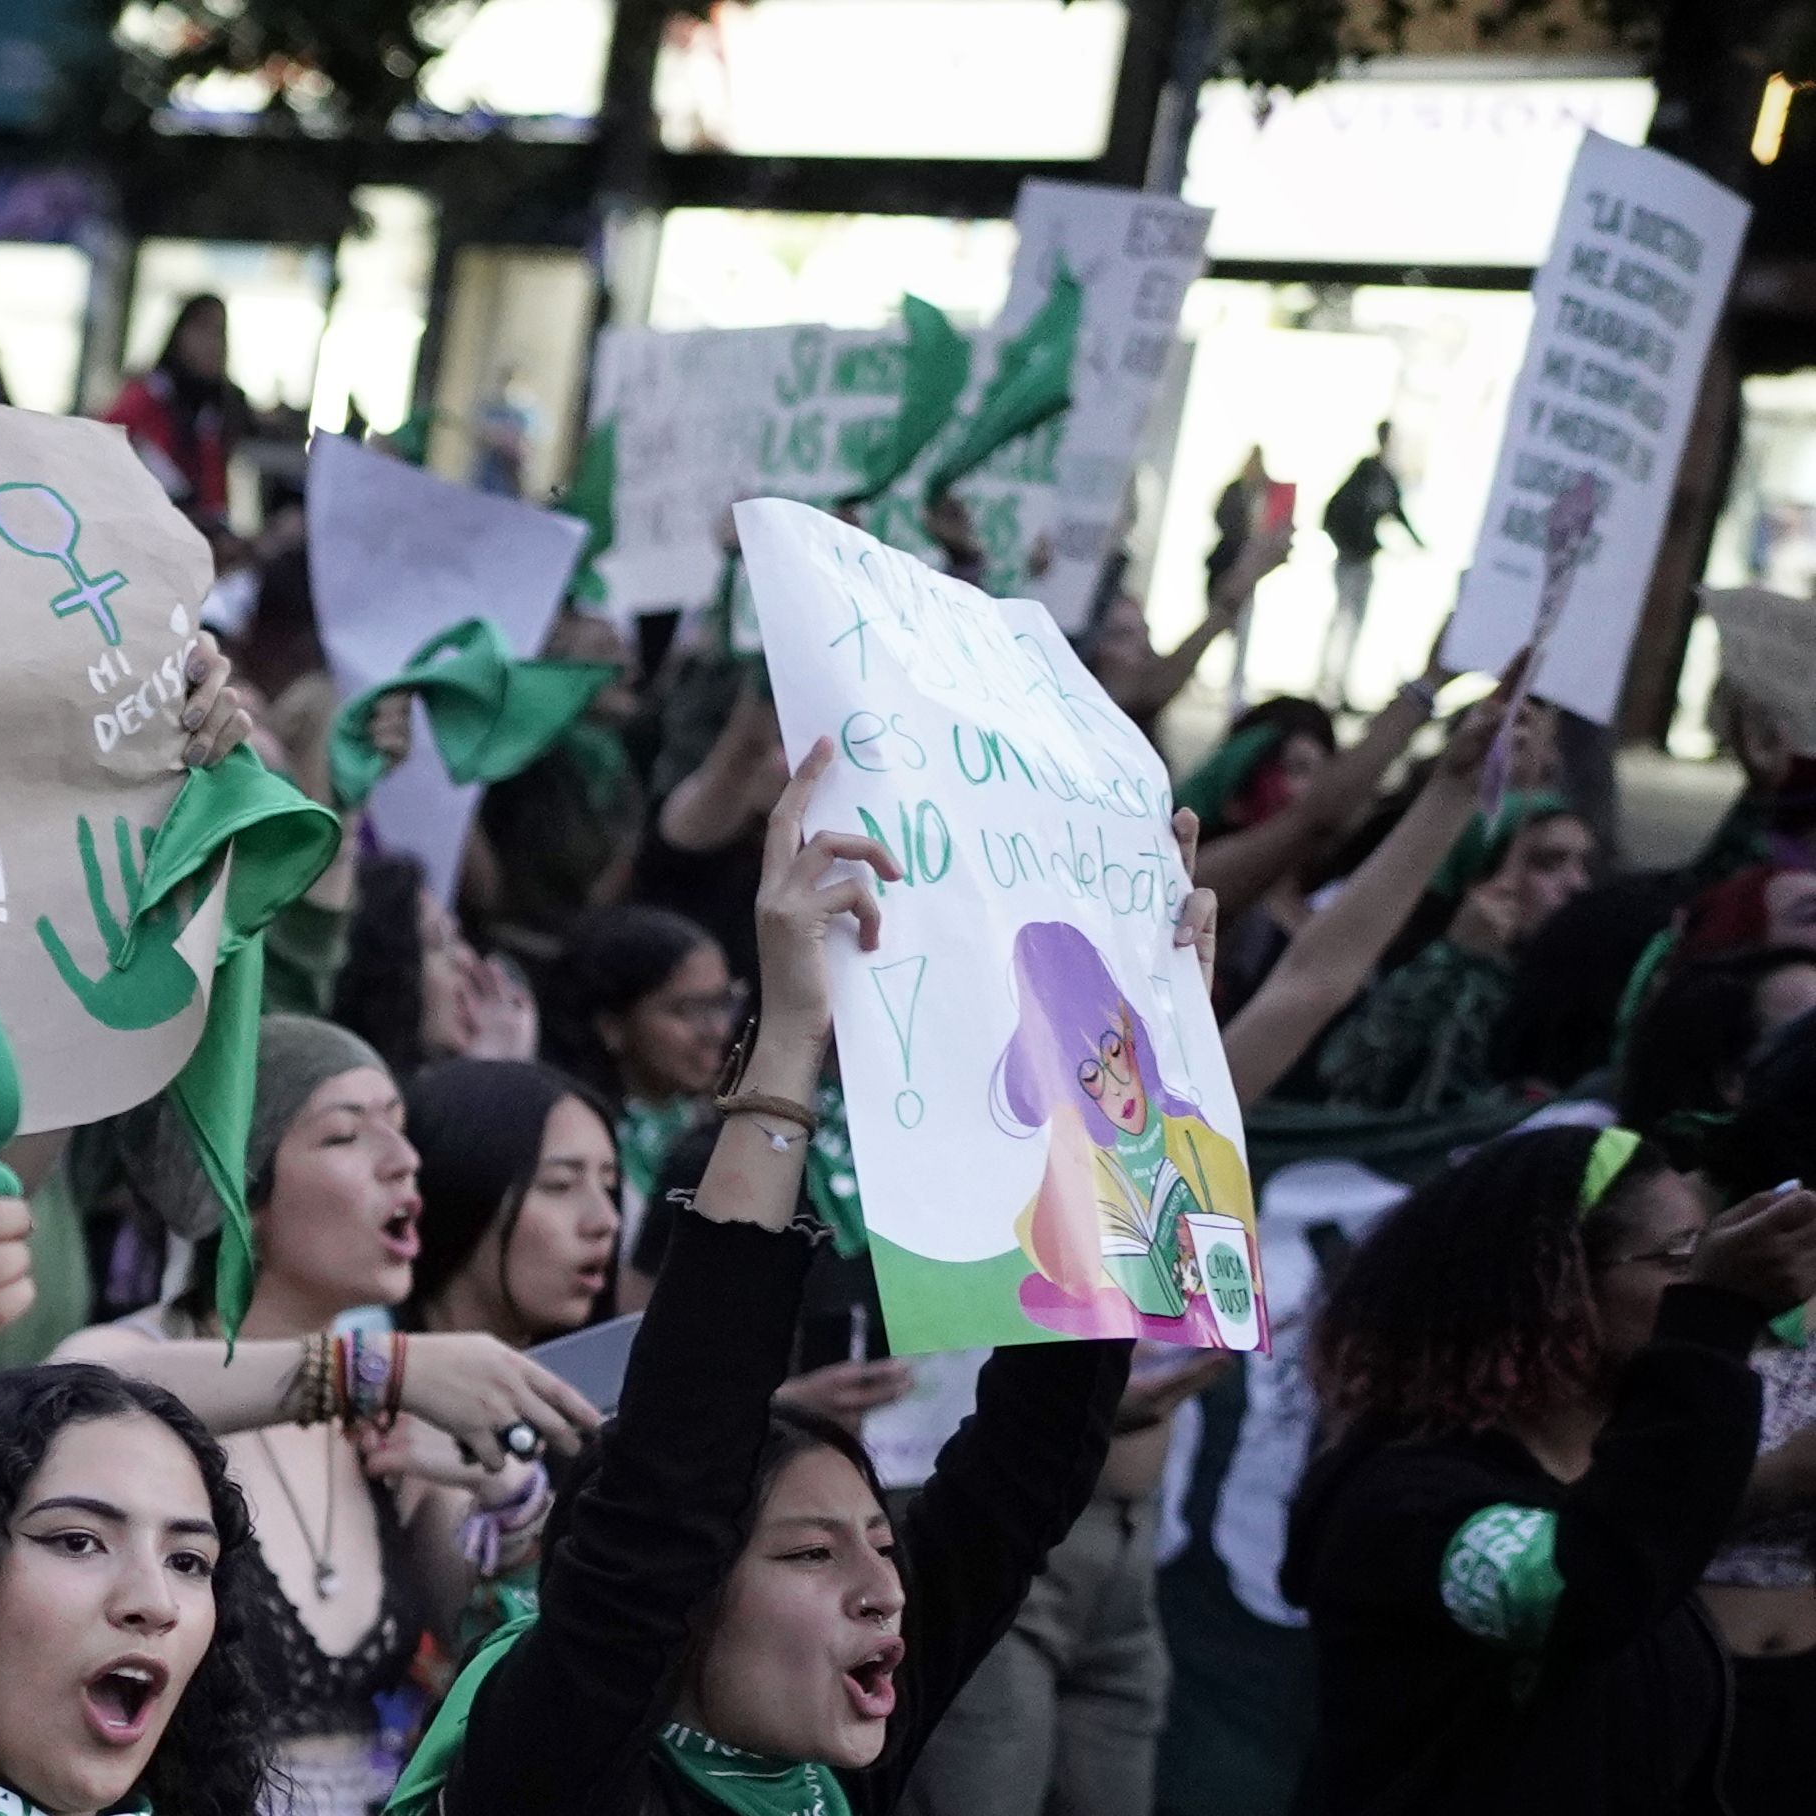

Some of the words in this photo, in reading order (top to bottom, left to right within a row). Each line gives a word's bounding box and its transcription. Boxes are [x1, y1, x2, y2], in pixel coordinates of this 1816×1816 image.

[88, 649, 133, 694] MI
[840, 711, 927, 772] es
[856, 799, 952, 897] NO
[980, 827, 1046, 889] un
[1207, 1253, 1246, 1281] CAUSA
[1213, 1287, 1251, 1315] JUSTA
